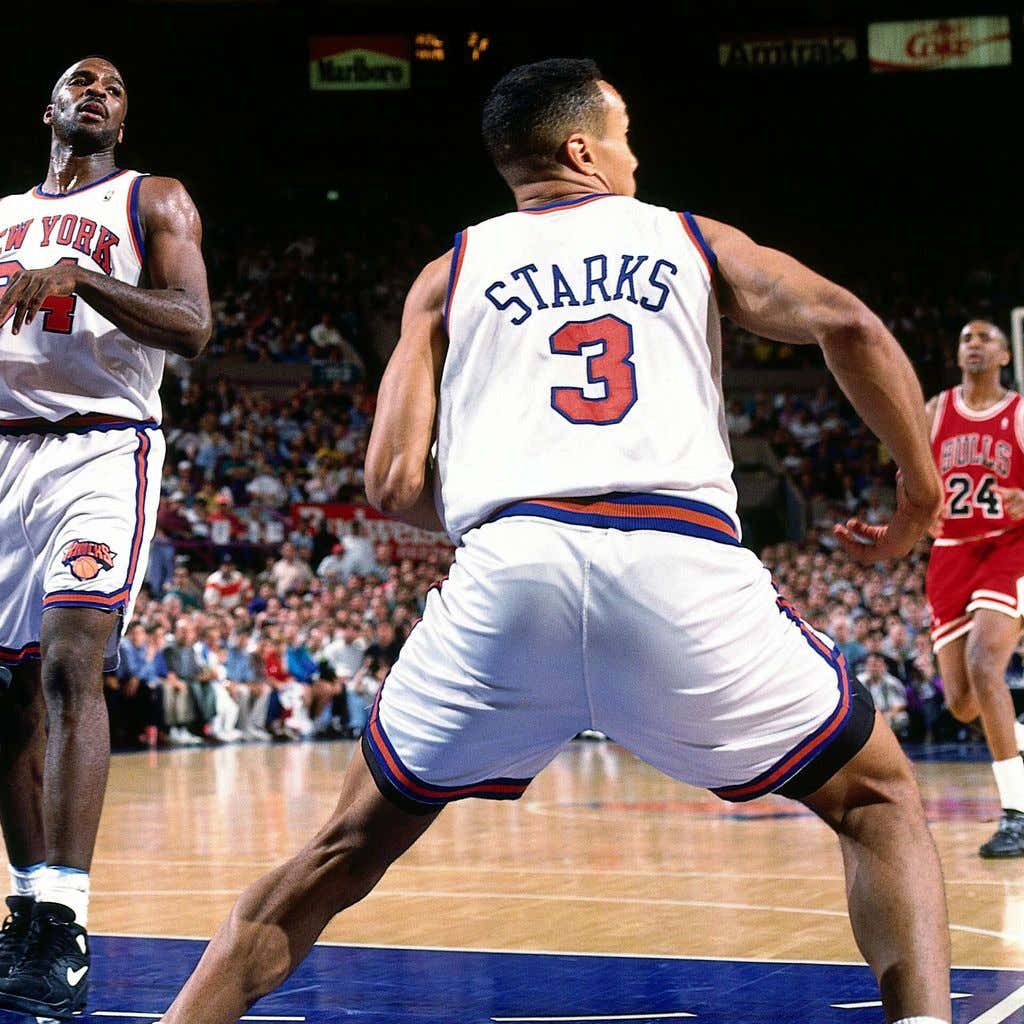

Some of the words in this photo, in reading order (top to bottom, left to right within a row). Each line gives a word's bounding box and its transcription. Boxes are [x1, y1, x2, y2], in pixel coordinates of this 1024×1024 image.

[319, 54, 403, 82] Marlboro
[39, 213, 120, 276] YORK
[484, 254, 678, 326] STARKS
[548, 312, 639, 426] 3
[941, 432, 1013, 479] BULLS
[943, 472, 1005, 520] 24
